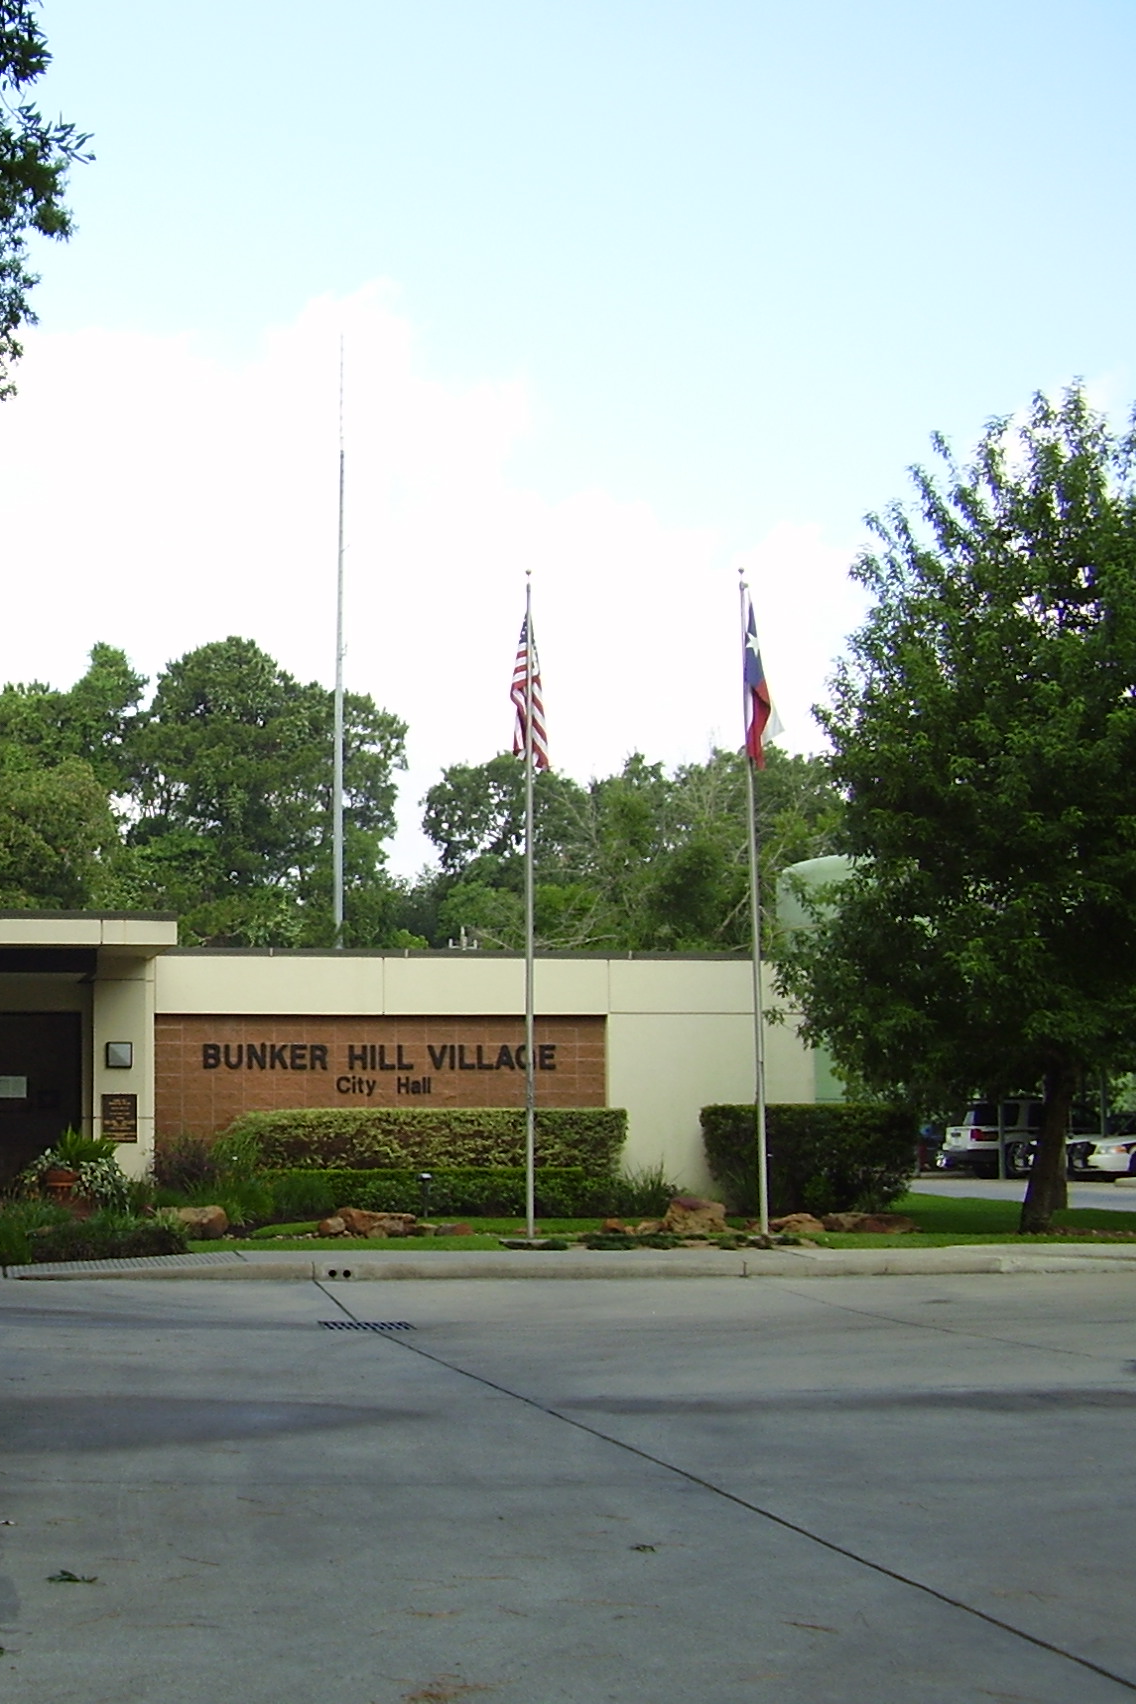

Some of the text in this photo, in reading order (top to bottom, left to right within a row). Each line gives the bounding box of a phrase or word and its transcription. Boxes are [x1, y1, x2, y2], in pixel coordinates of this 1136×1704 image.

[203, 1043, 557, 1071] BUNKER HILL VILLAGE
[336, 1076, 432, 1096] City Hall
